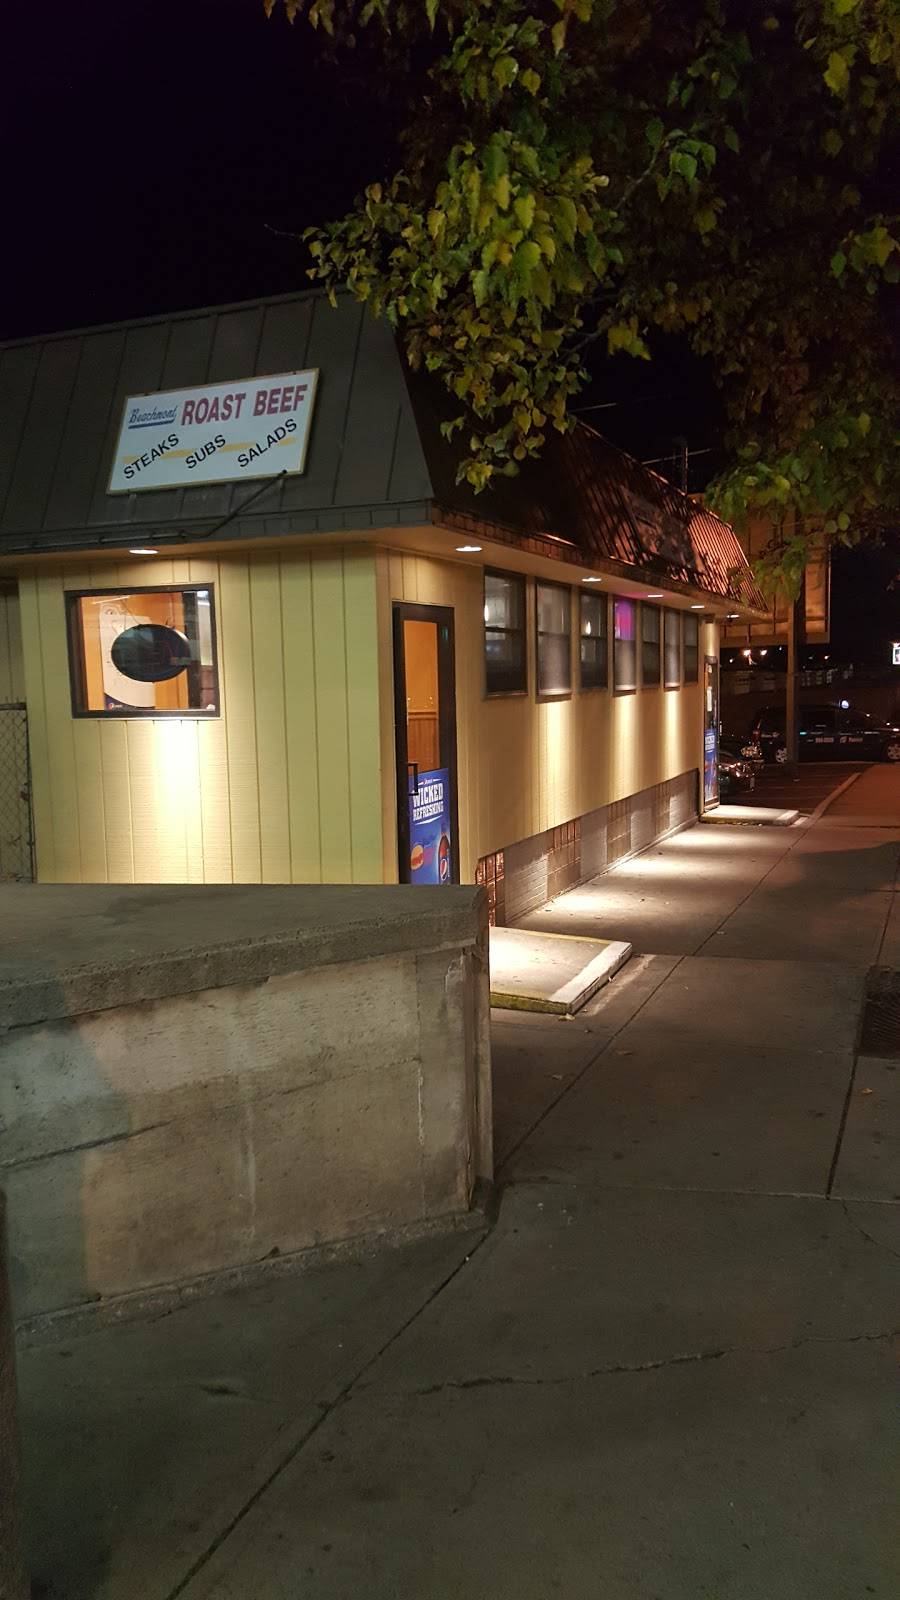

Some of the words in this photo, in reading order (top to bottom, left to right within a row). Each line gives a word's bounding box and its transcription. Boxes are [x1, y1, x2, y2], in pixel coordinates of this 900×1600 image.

[129, 404, 177, 424] Beachmont
[181, 393, 246, 426] ROAST
[253, 384, 308, 416] BEEF
[124, 433, 179, 479] STEAKS
[185, 434, 226, 469] SUBS
[237, 418, 297, 468] SALADS
[412, 782, 444, 808] WICKED
[412, 800, 444, 821] REFRESHING
